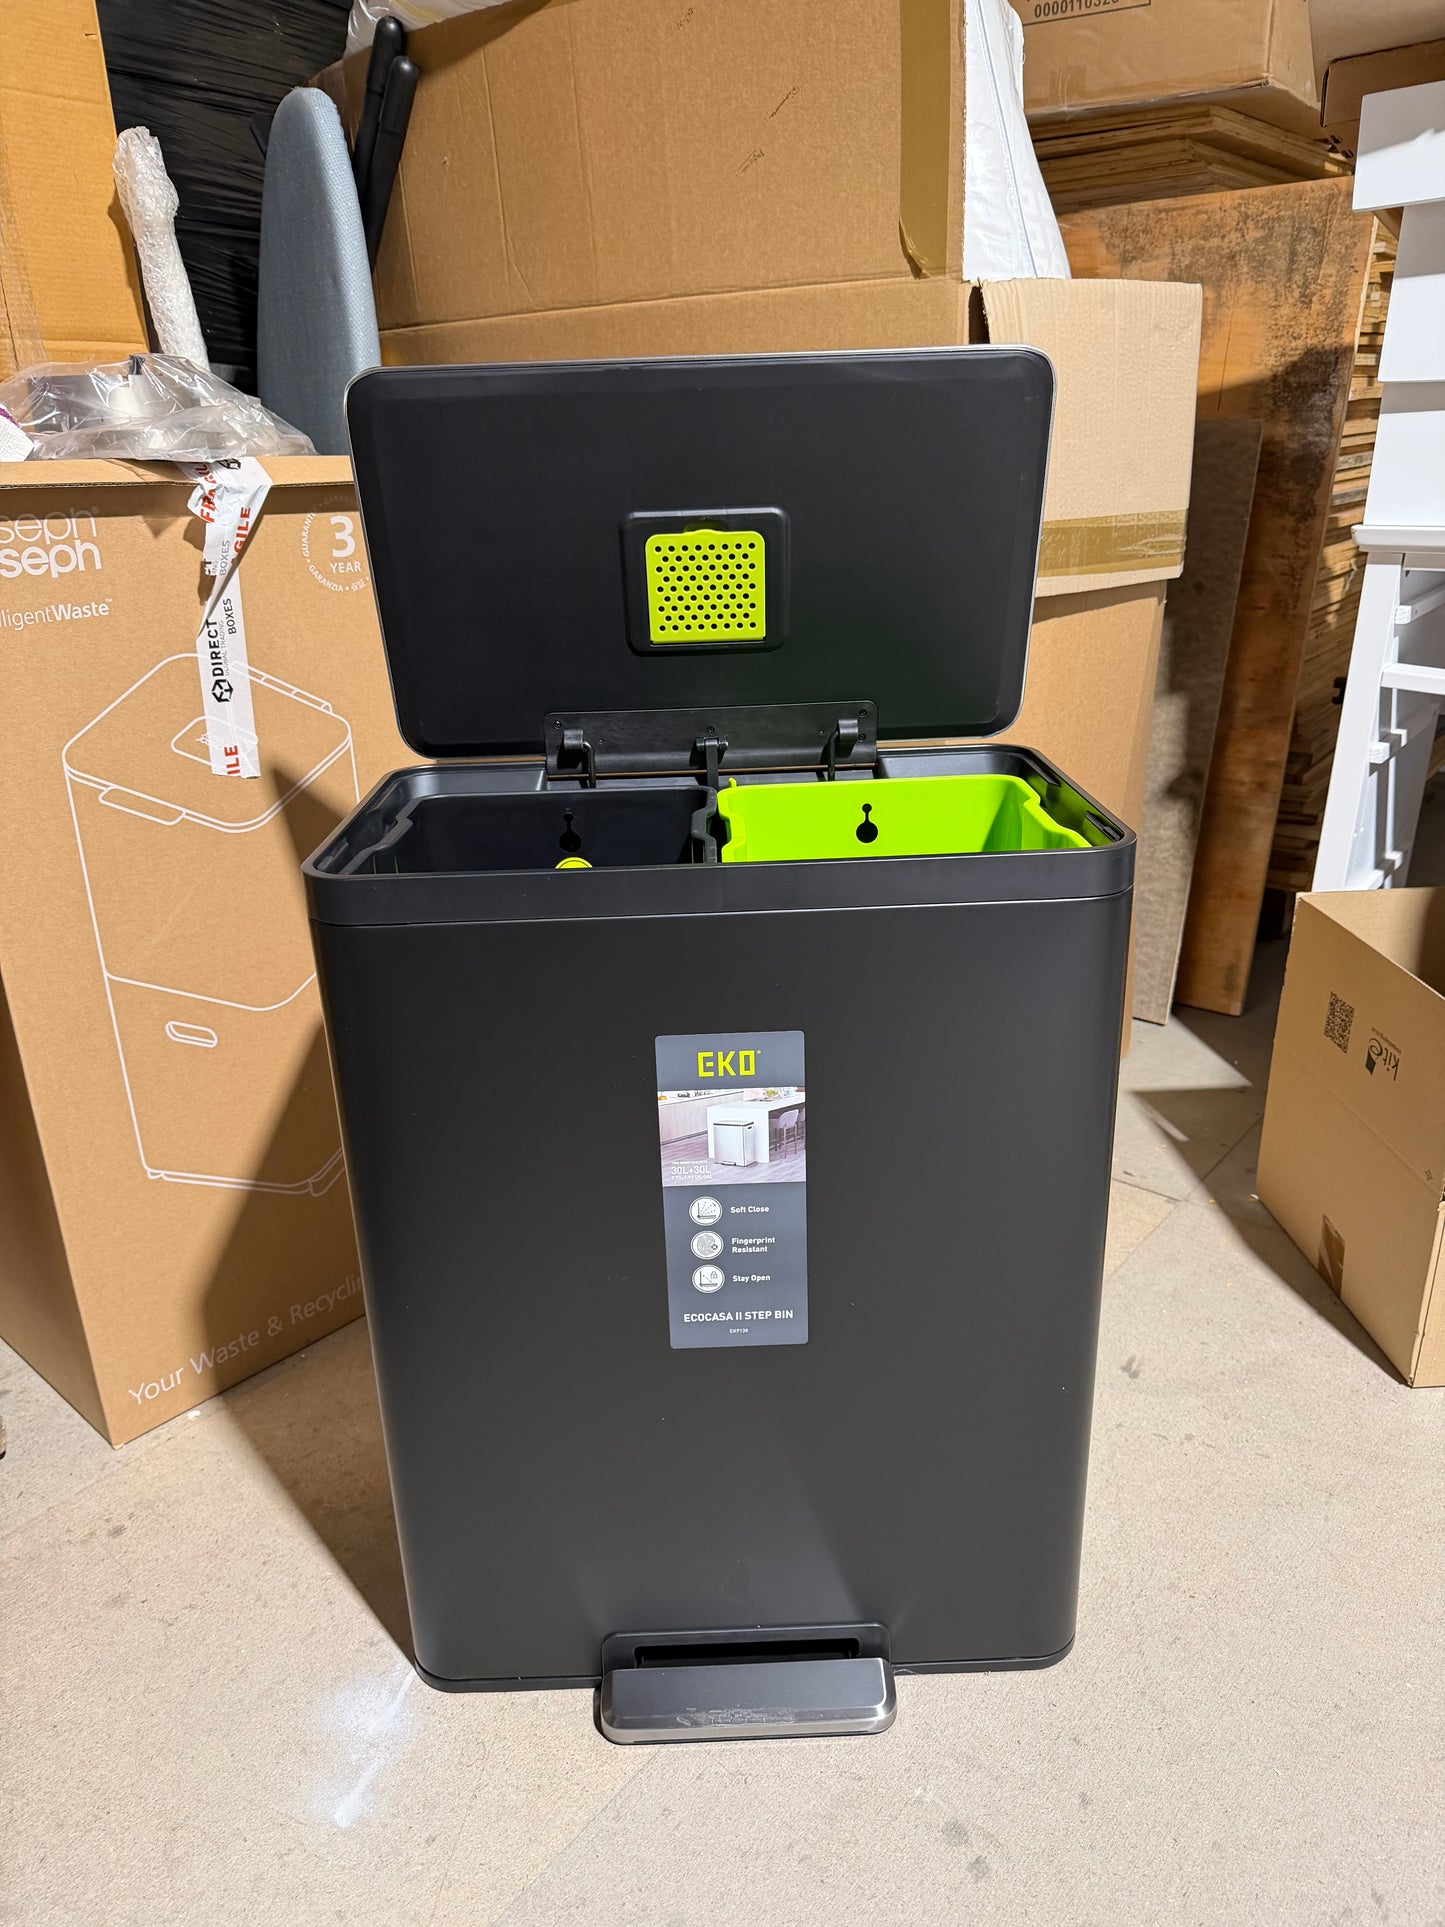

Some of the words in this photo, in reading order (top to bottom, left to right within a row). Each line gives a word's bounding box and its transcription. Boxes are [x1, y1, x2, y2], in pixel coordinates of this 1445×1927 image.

[330, 515, 356, 558] 3
[219, 539, 231, 576] BOXES
[329, 561, 362, 574] YEAR
[308, 564, 344, 592] GARANZIA
[222, 598, 237, 635] BOXES
[205, 619, 225, 677] DIRECT
[697, 1050, 755, 1077] EKO
[671, 1165, 711, 1175] 30L+30L
[730, 1206, 746, 1214] Soft
[748, 1205, 769, 1213] Close
[731, 1237, 776, 1247] Fingerprint
[732, 1246, 768, 1254] Resistant
[732, 1275, 749, 1283] Stay
[751, 1274, 771, 1283] Open
[683, 1312, 733, 1323] ECOCASA
[735, 1312, 742, 1321] II
[745, 1311, 772, 1321] STEP
[775, 1310, 794, 1319] BIN
[128, 1367, 184, 1405] Your
[189, 1330, 260, 1375] Waste
[267, 1315, 283, 1336] &
